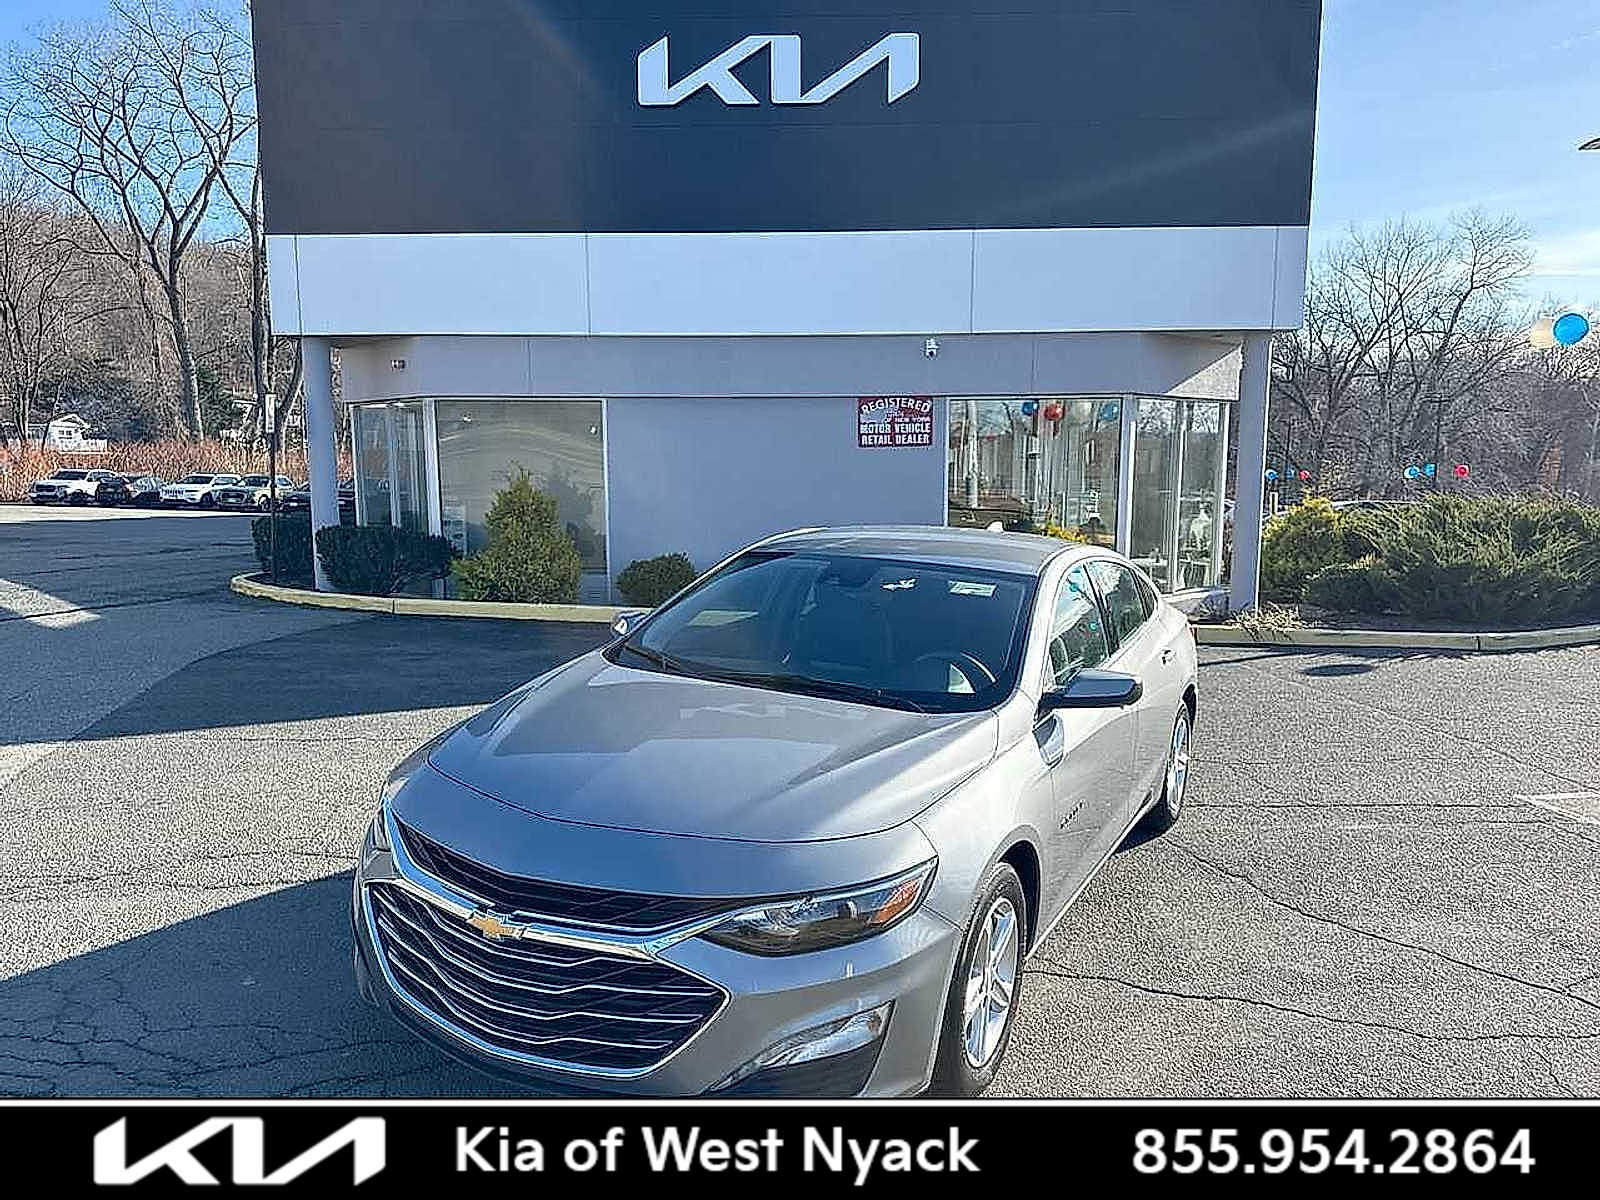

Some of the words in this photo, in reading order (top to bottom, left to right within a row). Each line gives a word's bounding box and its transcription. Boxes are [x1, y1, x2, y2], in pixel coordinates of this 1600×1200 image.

[637, 32, 920, 106] KIA
[860, 397, 932, 413] REGISTERED
[860, 423, 891, 433] MOTOR
[895, 422, 931, 433] VEHICLE
[861, 434, 893, 445] RETAIL
[895, 434, 930, 445] DEALER
